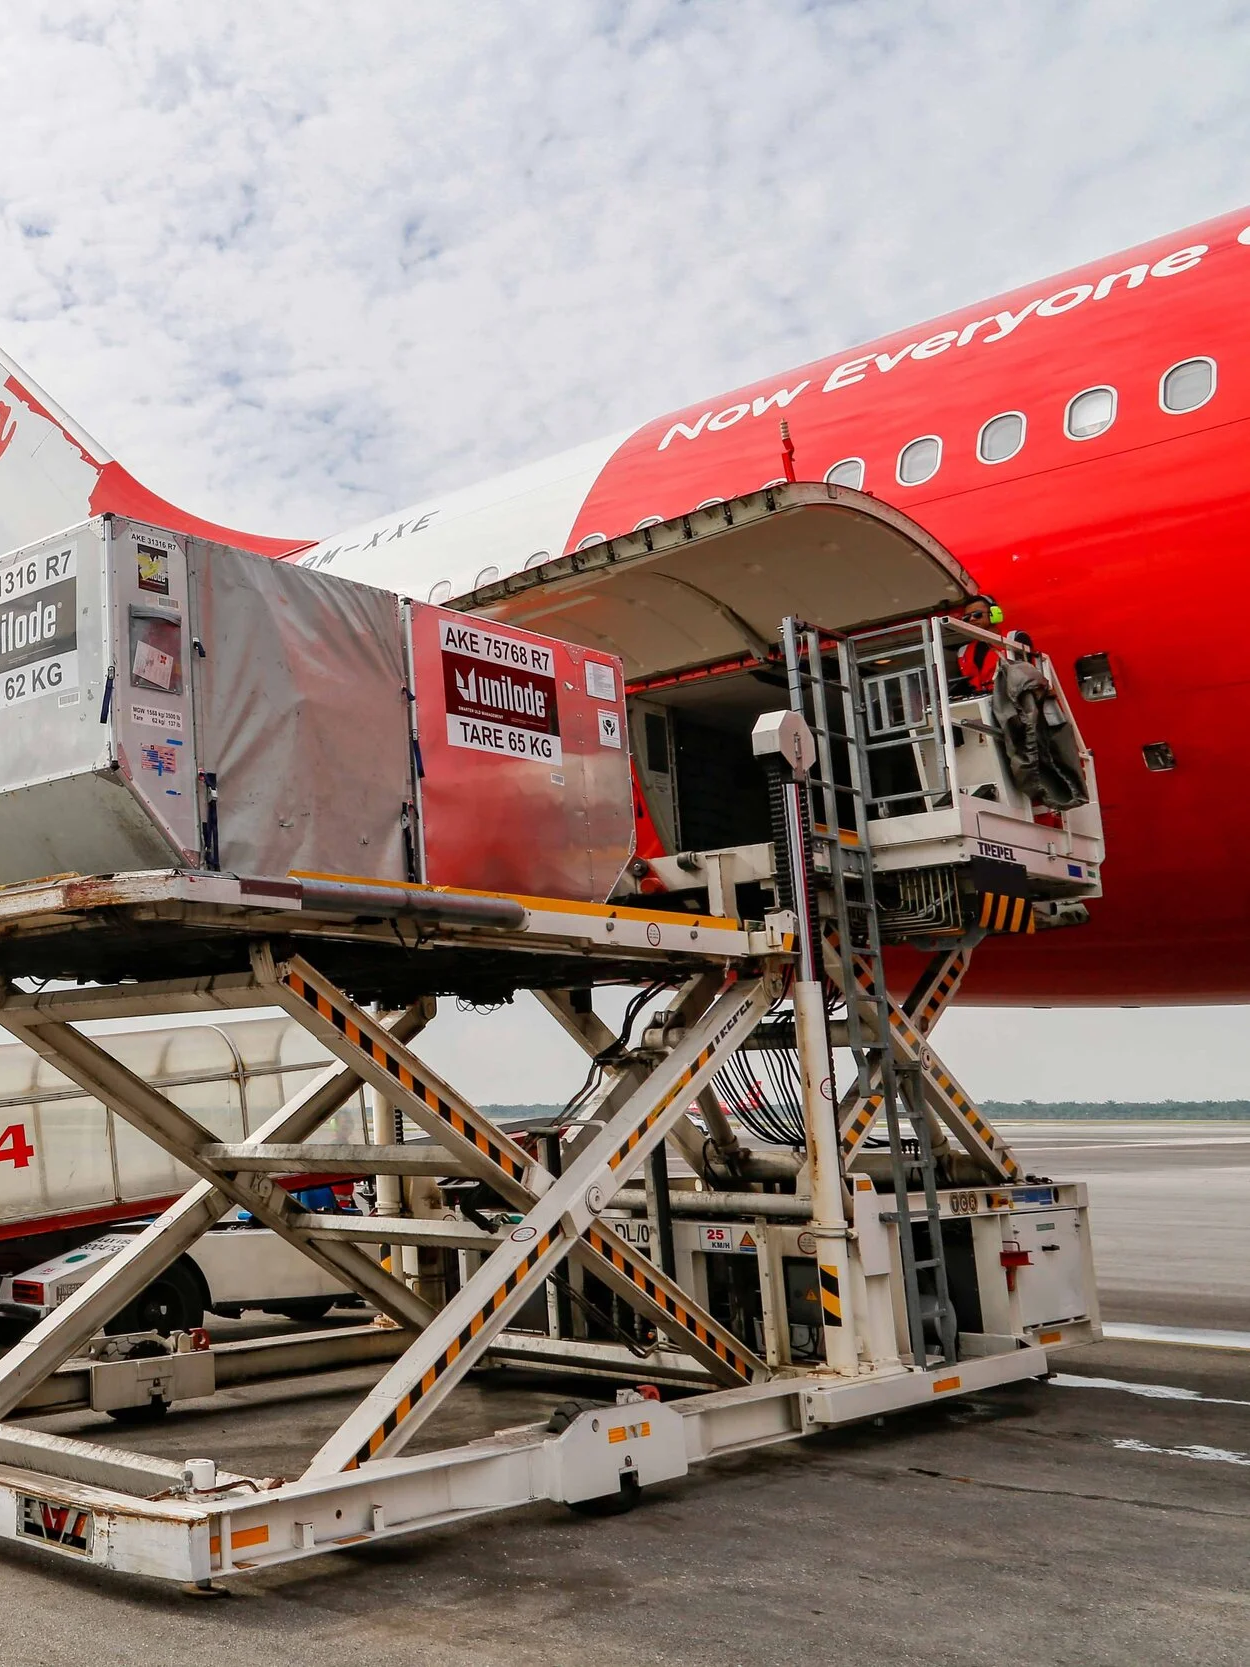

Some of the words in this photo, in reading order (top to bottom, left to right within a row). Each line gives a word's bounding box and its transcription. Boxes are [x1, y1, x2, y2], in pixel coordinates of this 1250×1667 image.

[658, 380, 810, 452] Now
[822, 244, 1209, 394] Everyone
[131, 533, 146, 543] AKE
[147, 537, 167, 549] 31316
[168, 543, 177, 551] R7
[46, 549, 71, 580] R7
[446, 627, 480, 654] AKE
[484, 637, 528, 665] 75768
[531, 649, 549, 671] R7
[5, 673, 26, 701] 62
[32, 662, 63, 693] KG
[478, 675, 546, 718] unilode
[133, 713, 144, 721] Tare
[459, 721, 504, 749] TARE
[508, 731, 526, 753] 65
[530, 735, 552, 758] KG
[951, 1192, 978, 1214] TCR
[707, 1228, 725, 1240] 25
[711, 1241, 730, 1249] KM/H
